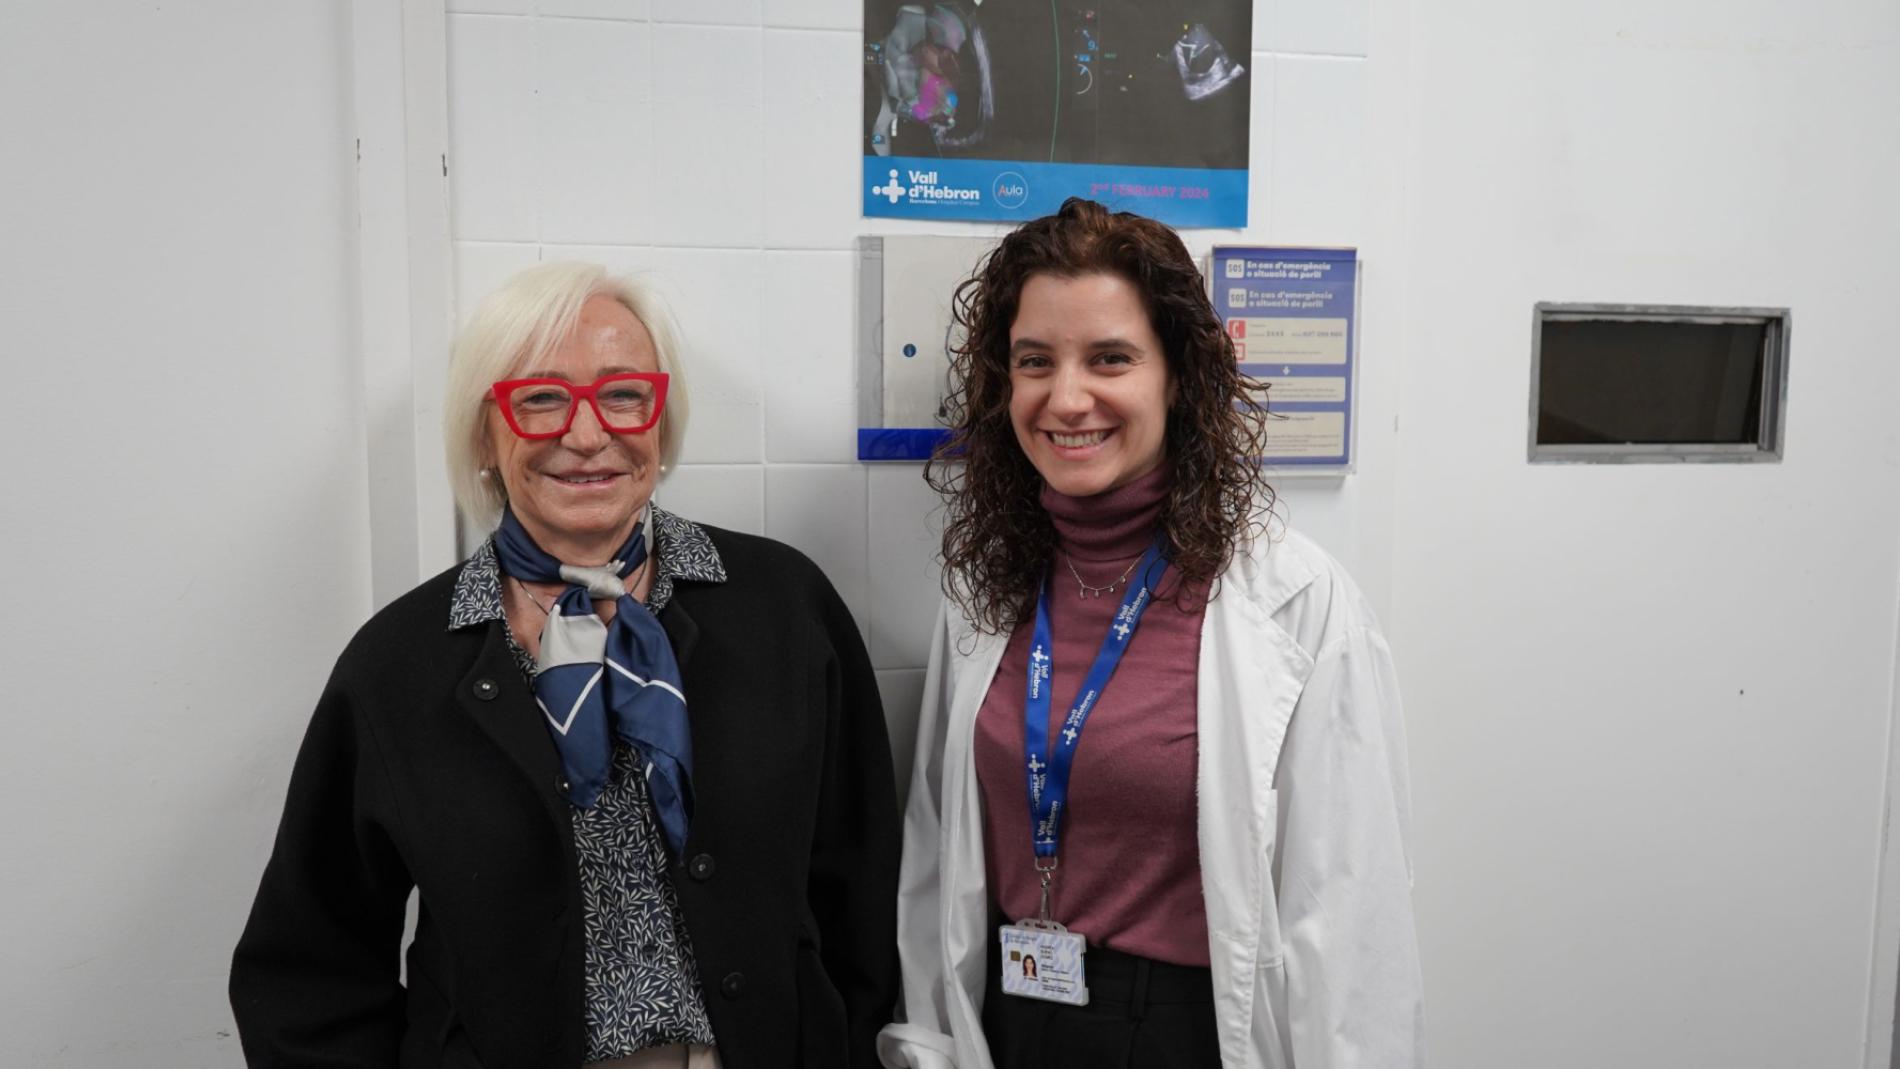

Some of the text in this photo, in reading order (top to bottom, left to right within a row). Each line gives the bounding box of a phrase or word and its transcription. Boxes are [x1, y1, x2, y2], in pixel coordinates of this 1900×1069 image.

[908, 170, 938, 185] Vall
[908, 185, 980, 200] d'Hebron
[999, 184, 1024, 195] Aula
[1112, 184, 1176, 197] FEBRUARY
[1228, 263, 1242, 273] SOS
[1247, 261, 1257, 269] En
[1258, 262, 1274, 270] cas
[1288, 271, 1299, 279] de
[1300, 271, 1323, 280] perill
[1230, 293, 1244, 303] SOS
[1249, 291, 1260, 299] En
[1290, 300, 1301, 308] de
[1116, 604, 1130, 620] Vall
[1066, 708, 1078, 725] Vall
